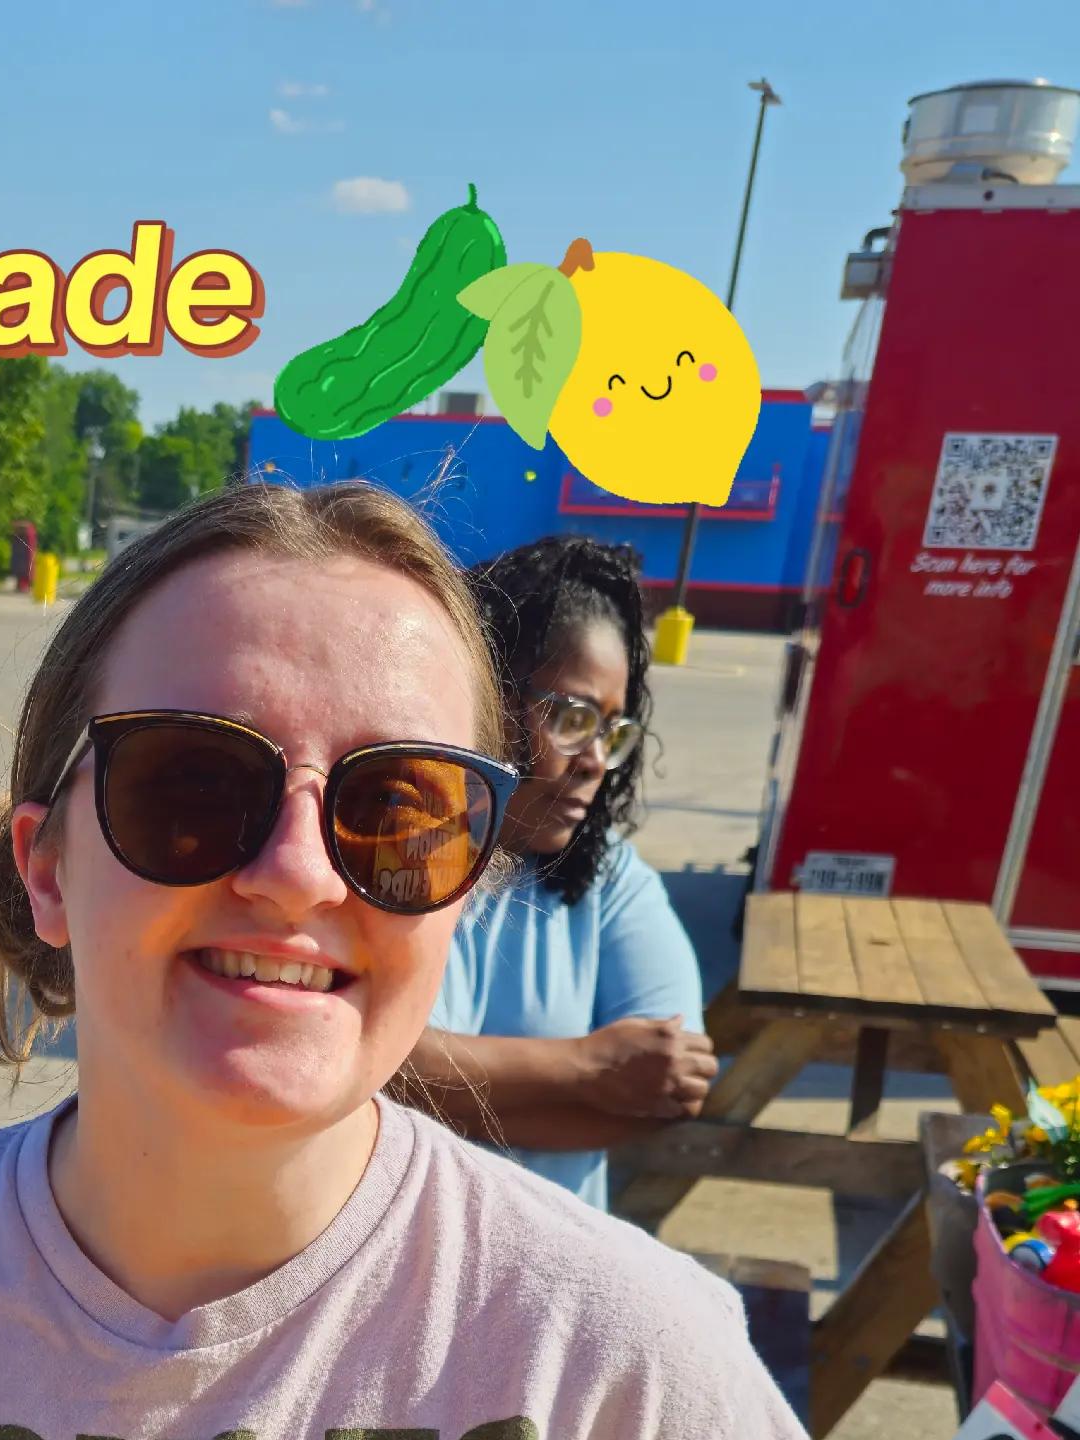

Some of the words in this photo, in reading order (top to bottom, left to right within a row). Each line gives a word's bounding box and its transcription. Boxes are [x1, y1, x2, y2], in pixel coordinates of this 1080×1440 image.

[910, 553, 957, 573] Scan
[958, 553, 1002, 575] here
[1003, 553, 1037, 576] for
[923, 581, 972, 597] more
[973, 578, 1013, 599] info
